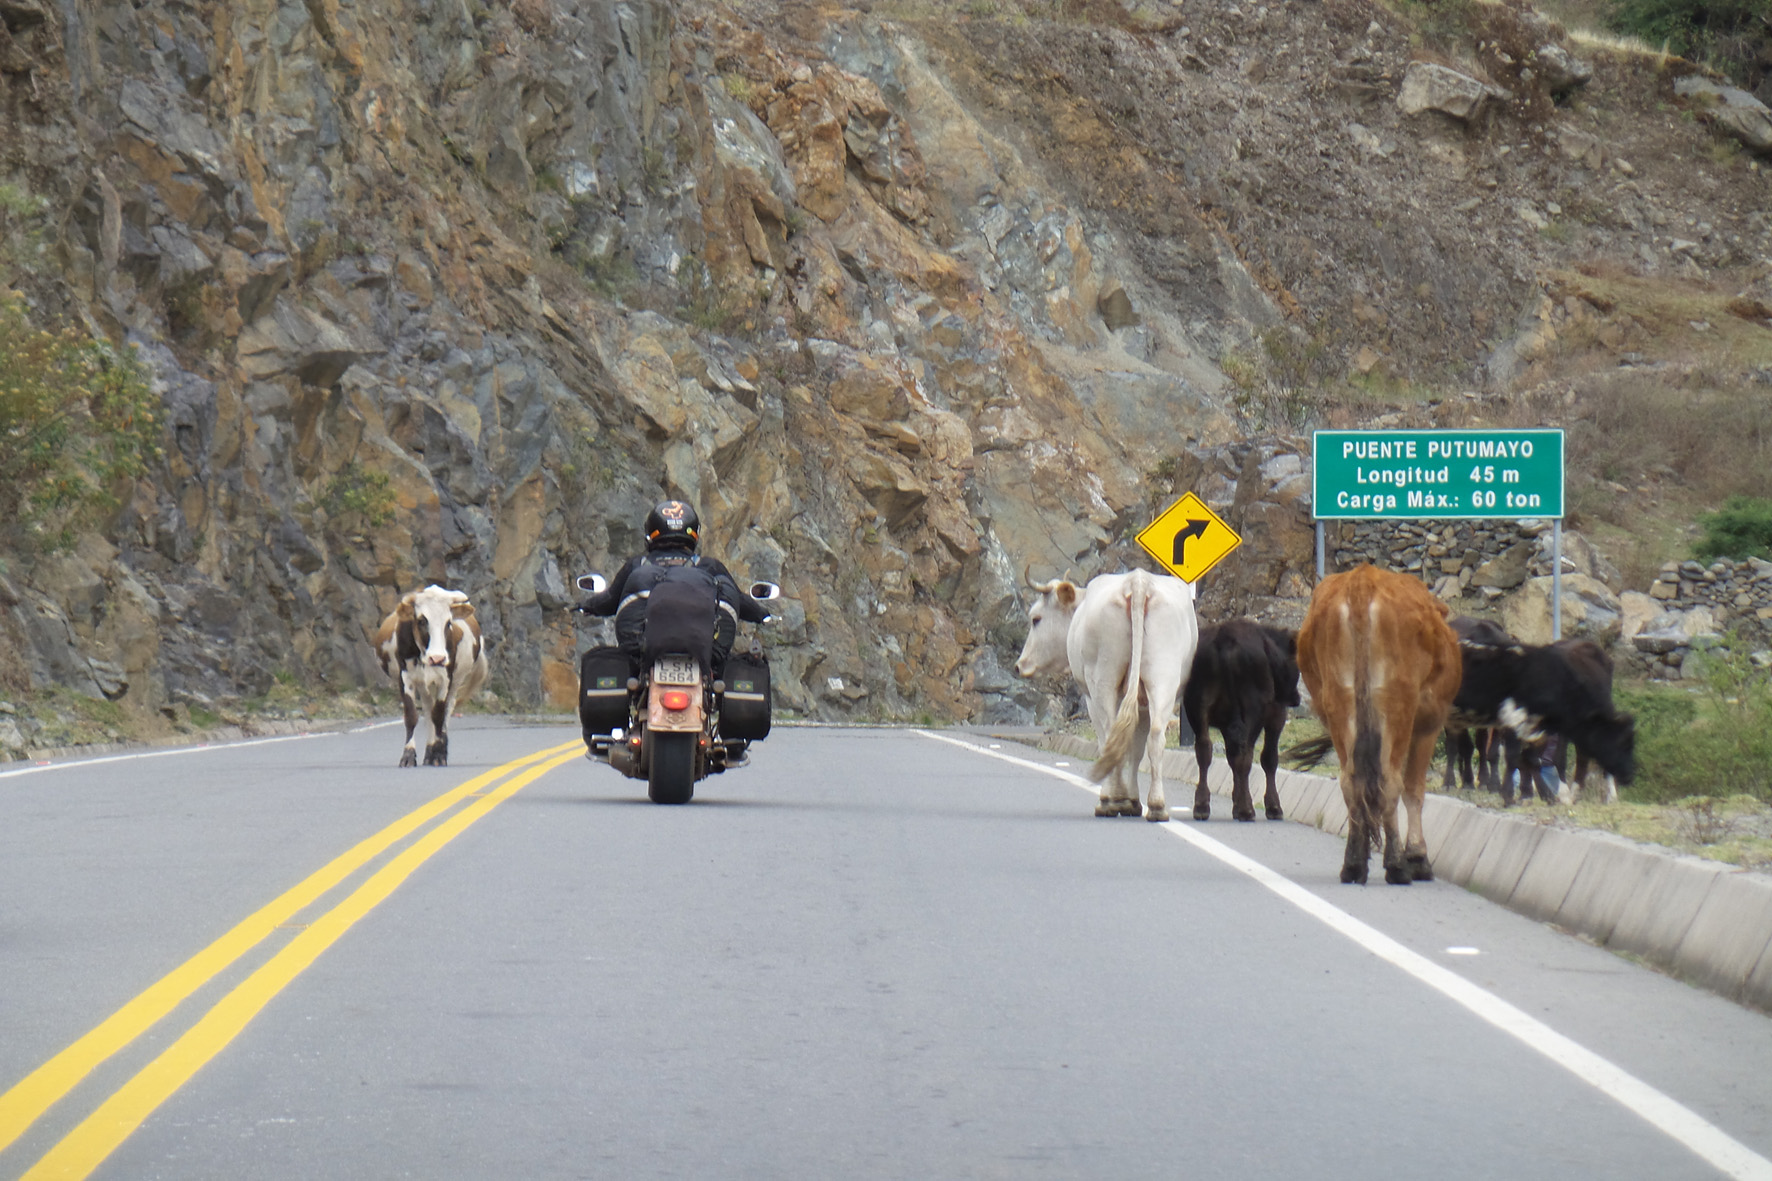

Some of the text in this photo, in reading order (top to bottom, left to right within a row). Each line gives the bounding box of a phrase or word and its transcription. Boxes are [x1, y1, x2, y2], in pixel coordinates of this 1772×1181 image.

[1342, 440, 1534, 459] PUENTE PUTUMAYO
[1357, 465, 1520, 488] Longitud 45 m
[1337, 490, 1541, 513] Carga Máx.: 60 ton
[659, 671, 694, 683] 6564
